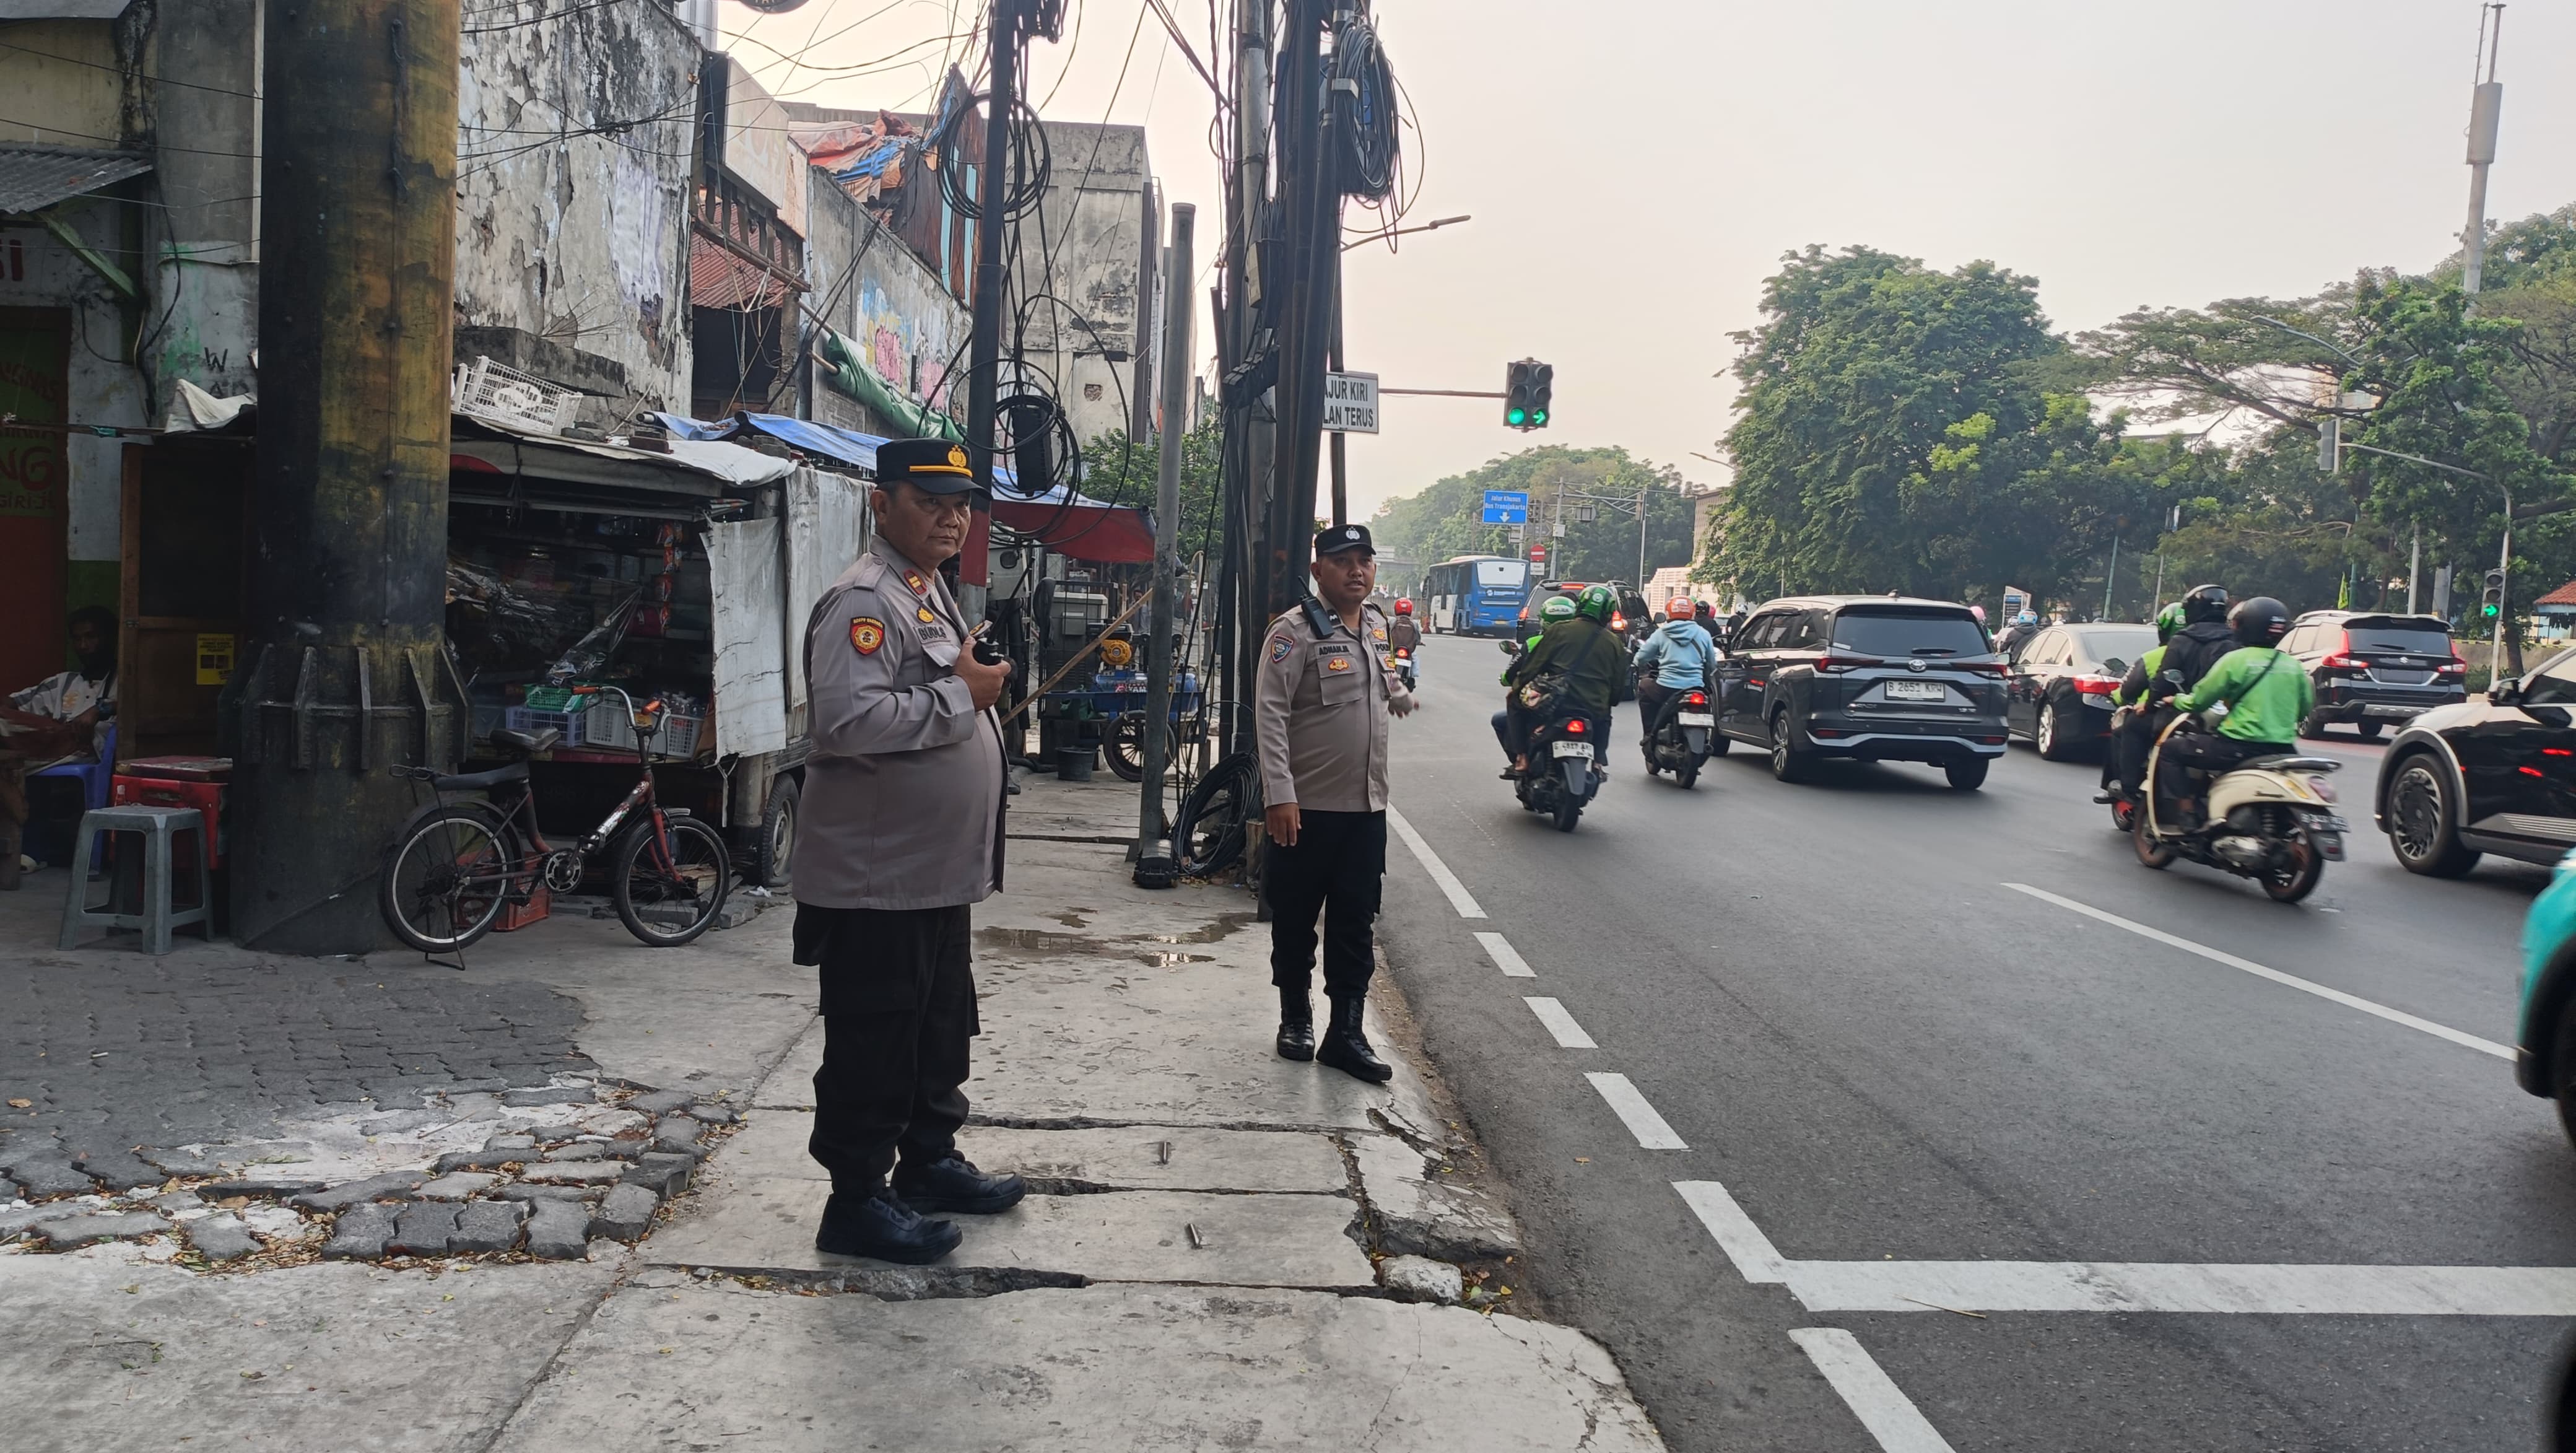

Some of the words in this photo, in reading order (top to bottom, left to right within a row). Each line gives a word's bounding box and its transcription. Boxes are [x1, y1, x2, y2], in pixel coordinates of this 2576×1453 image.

[1350, 381, 1368, 402] KIRI
[1344, 406, 1373, 427] TERUS
[1495, 503, 1526, 511] Transjakarta
[1888, 681, 1894, 692] B
